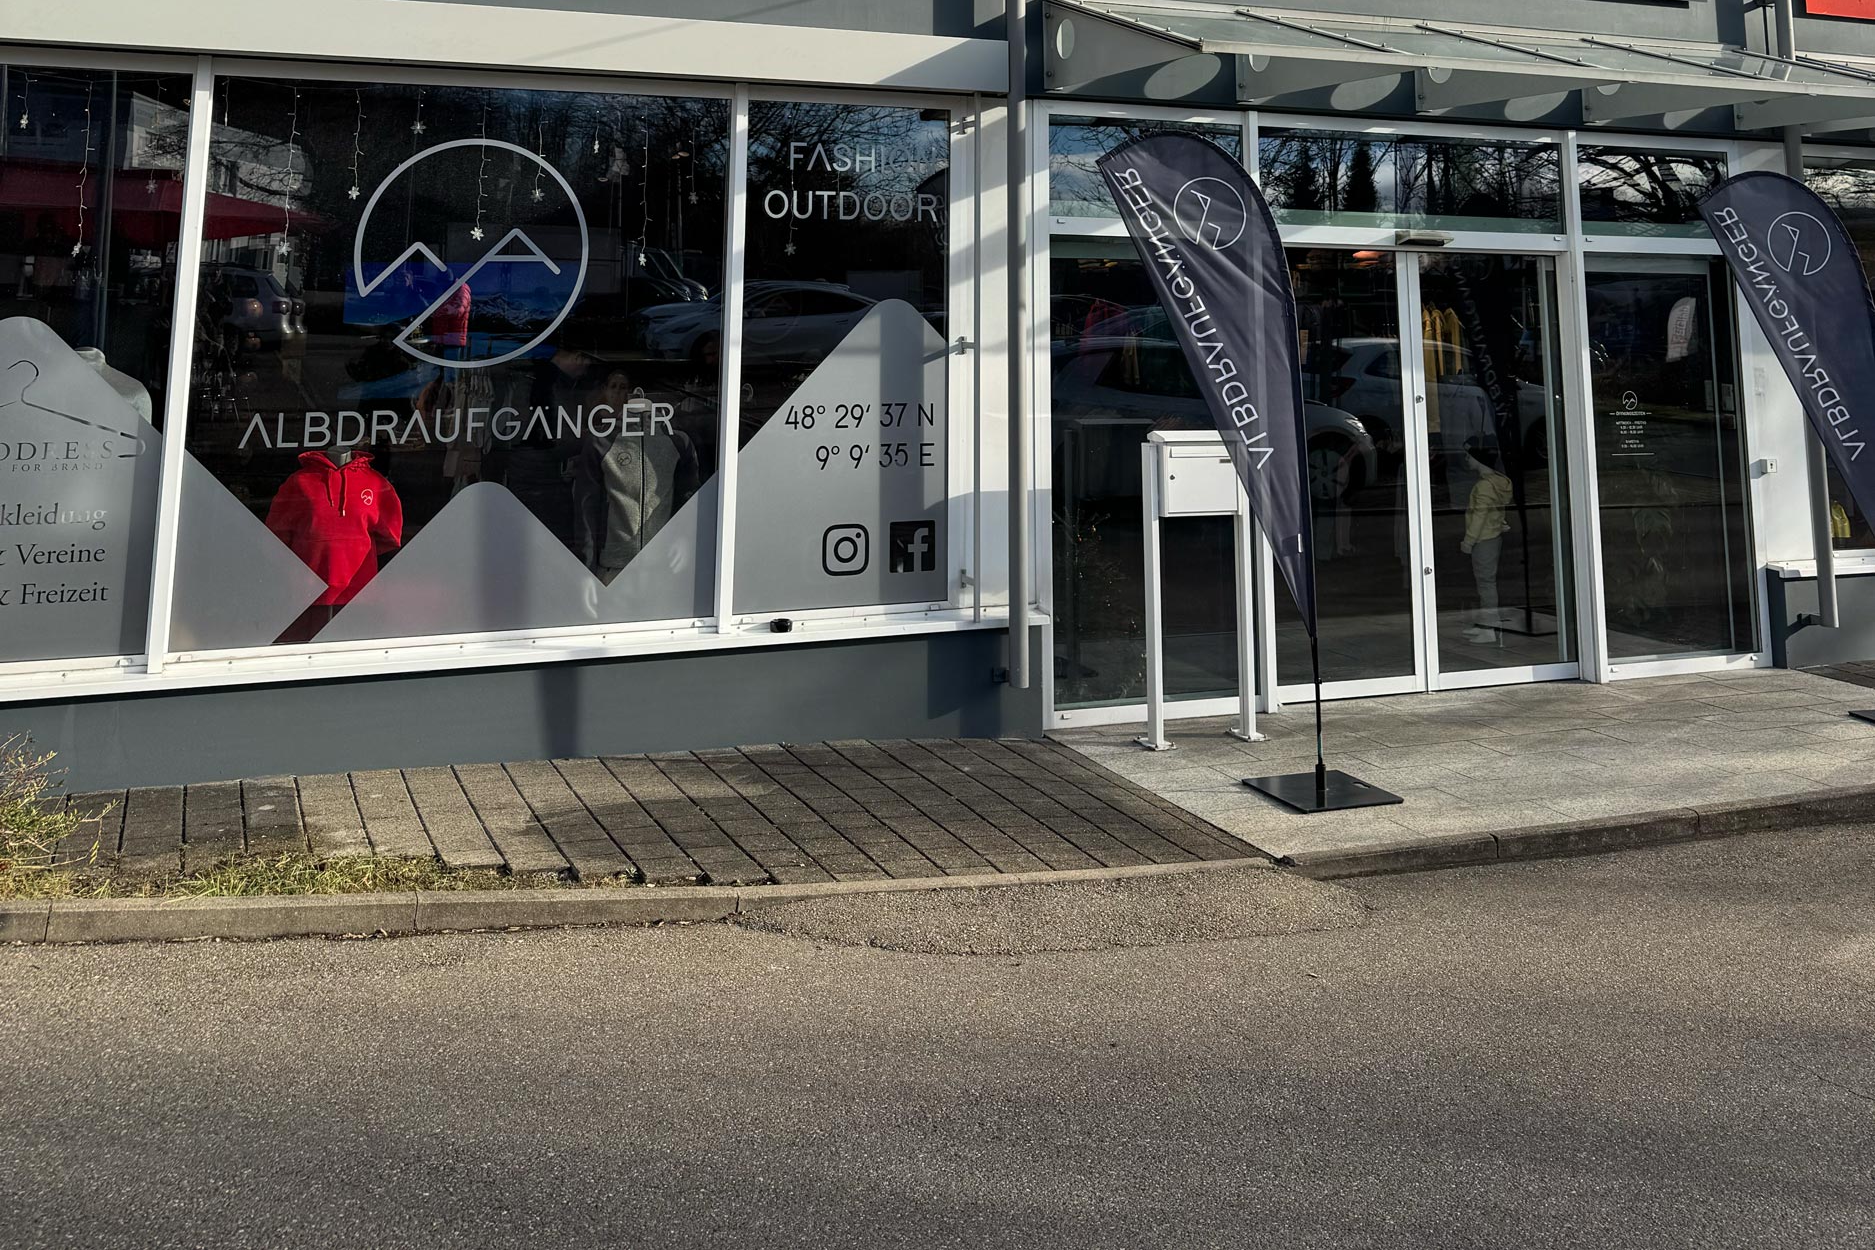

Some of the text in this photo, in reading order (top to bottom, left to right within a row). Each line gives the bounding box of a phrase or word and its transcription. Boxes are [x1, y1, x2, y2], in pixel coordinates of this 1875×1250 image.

[763, 189, 938, 223] OUTDOOR
[237, 401, 676, 450] ALBDRAUFGÄNGER
[879, 402, 908, 428] 37
[917, 402, 934, 427] N
[11, 462, 42, 473] FOR
[878, 442, 909, 468] 35
[919, 442, 935, 467] E
[15, 542, 107, 566] Vereine
[19, 580, 110, 606] Freizeit
